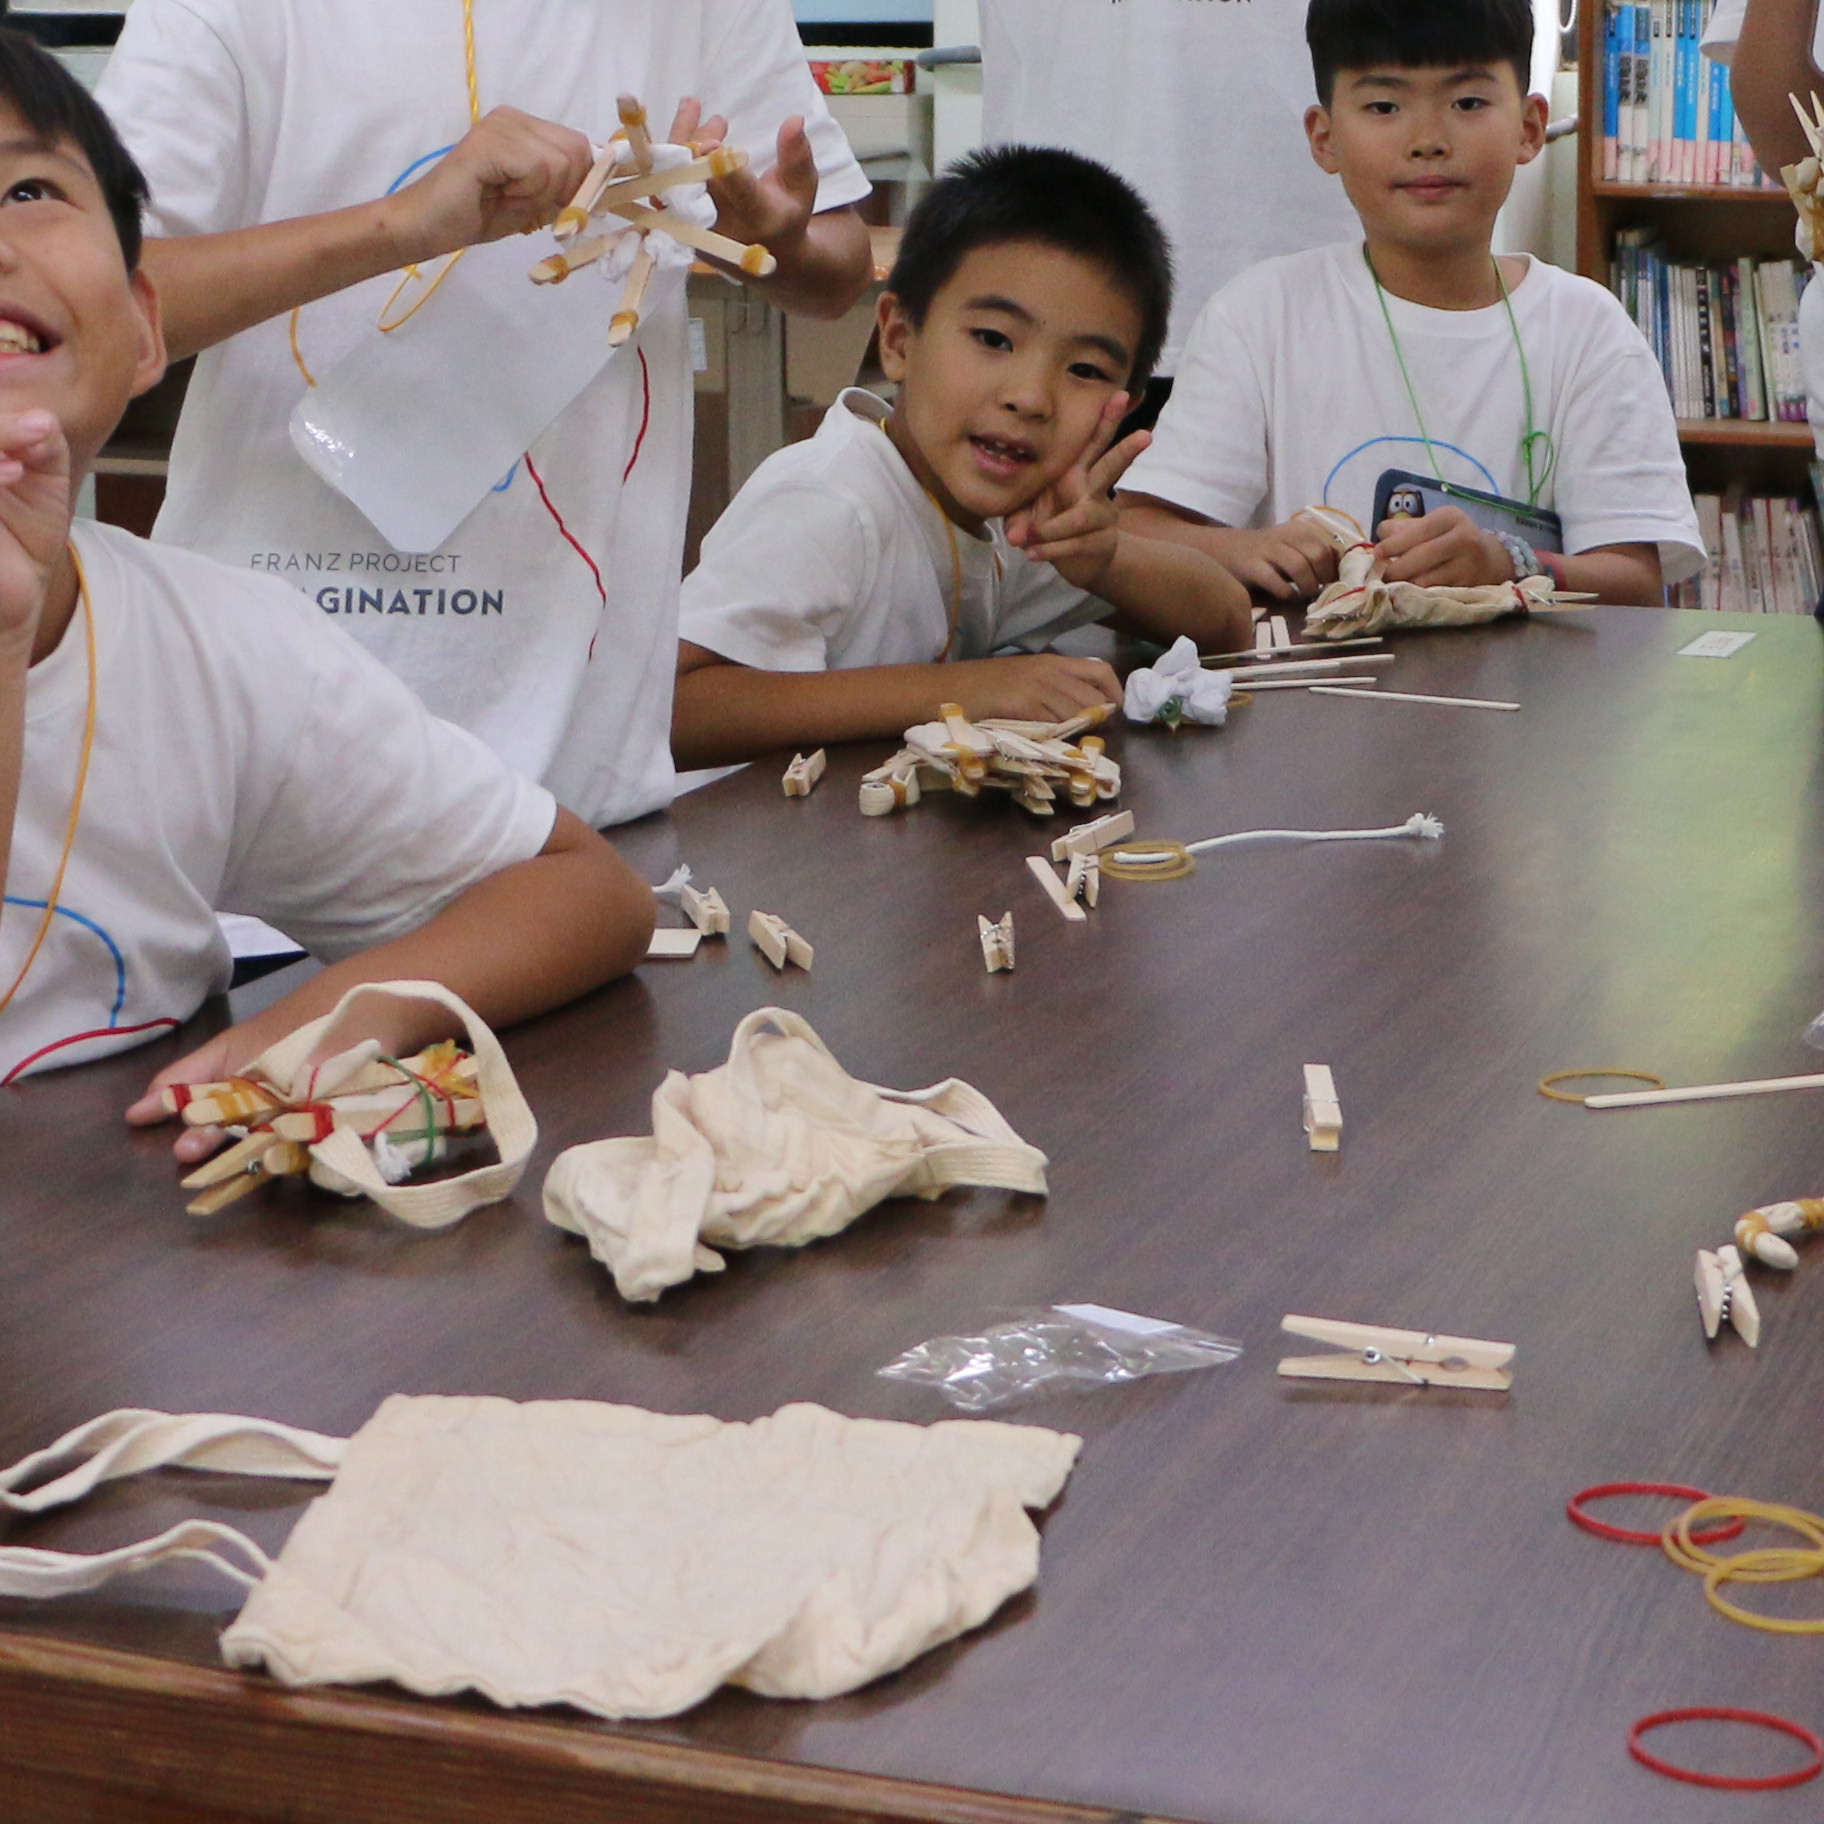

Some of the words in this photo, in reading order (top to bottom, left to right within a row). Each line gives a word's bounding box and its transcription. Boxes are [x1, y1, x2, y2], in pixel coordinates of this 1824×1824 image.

[251, 552, 341, 572] FRANZ
[349, 552, 462, 573] PROJECT
[300, 586, 504, 615] GINATION
